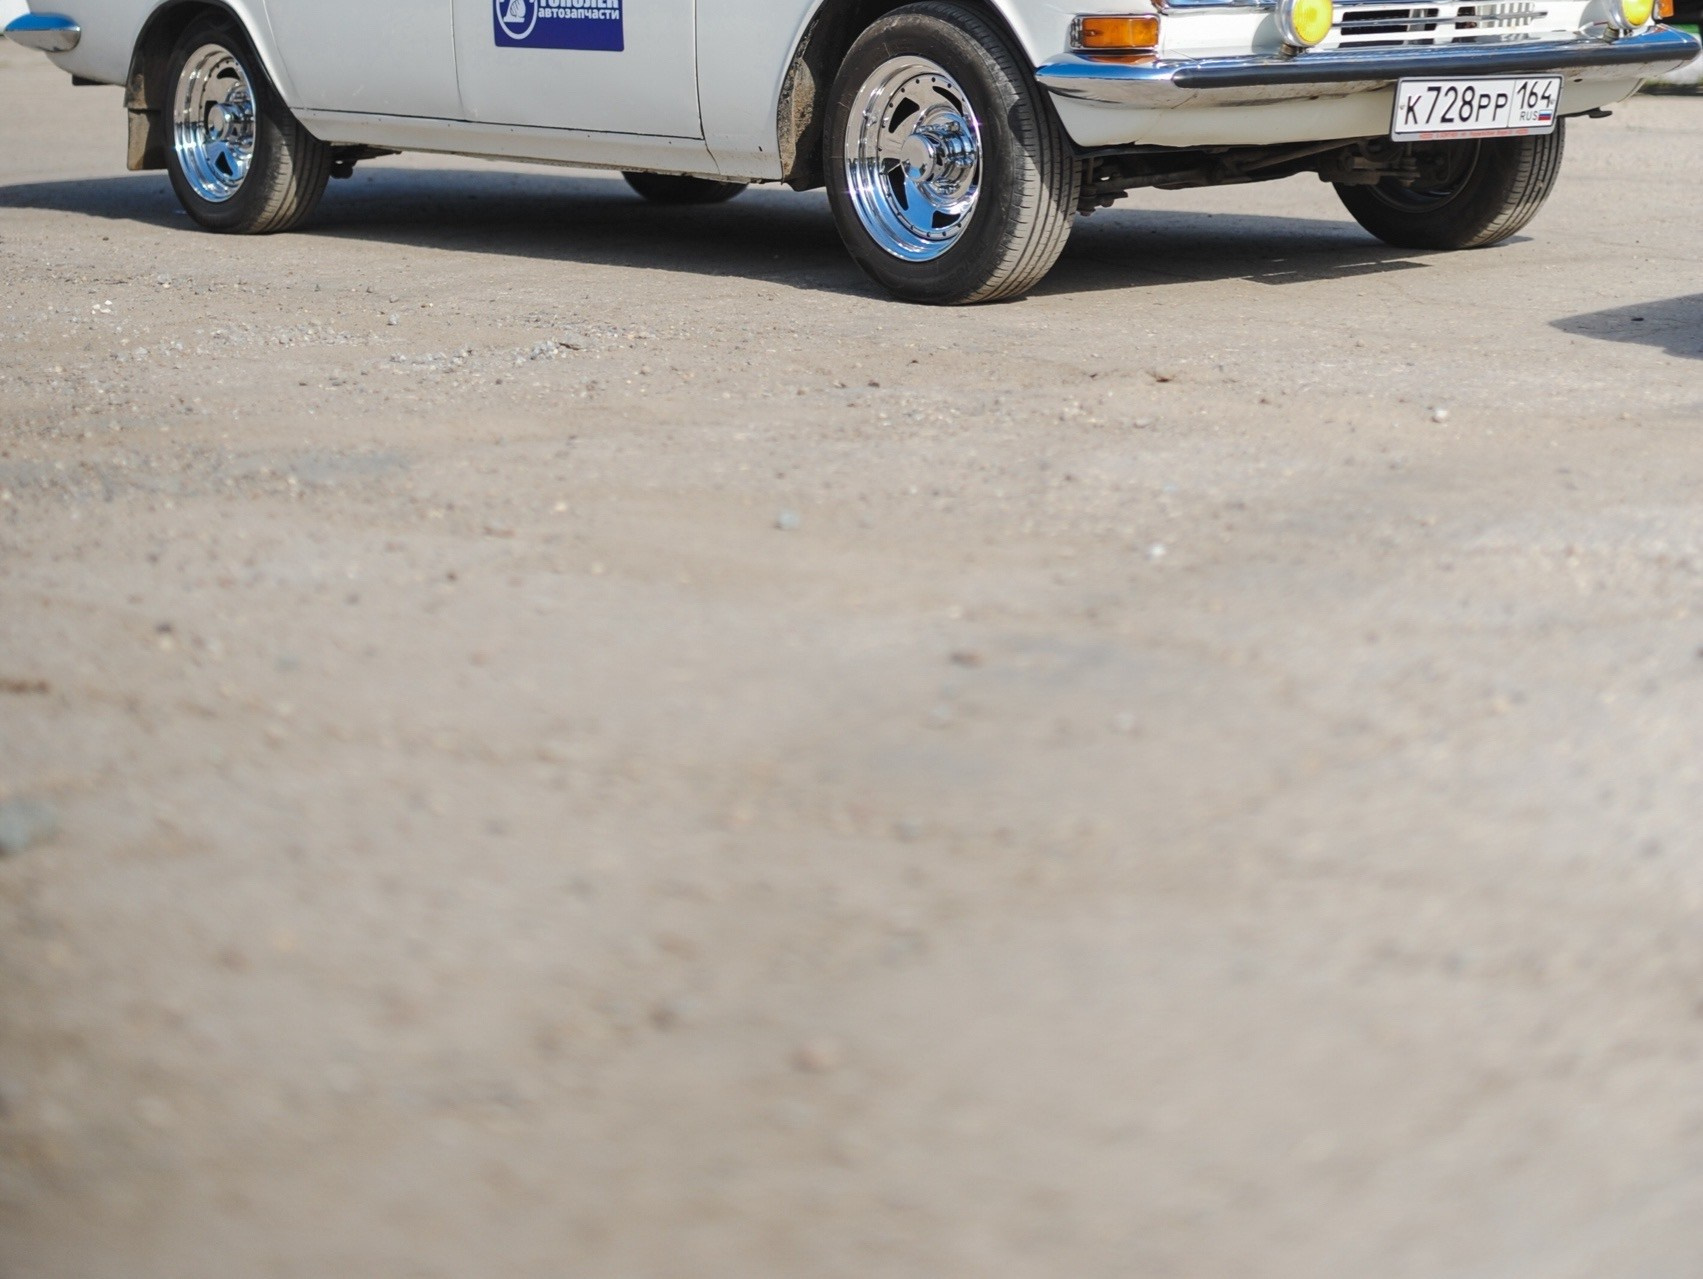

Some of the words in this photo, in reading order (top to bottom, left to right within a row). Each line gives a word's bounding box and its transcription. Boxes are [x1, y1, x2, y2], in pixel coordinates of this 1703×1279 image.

[538, 7, 620, 20] автозапчасти
[1404, 85, 1508, 125] К728РР
[1517, 80, 1553, 109] 164
[1519, 110, 1538, 121] RUS
